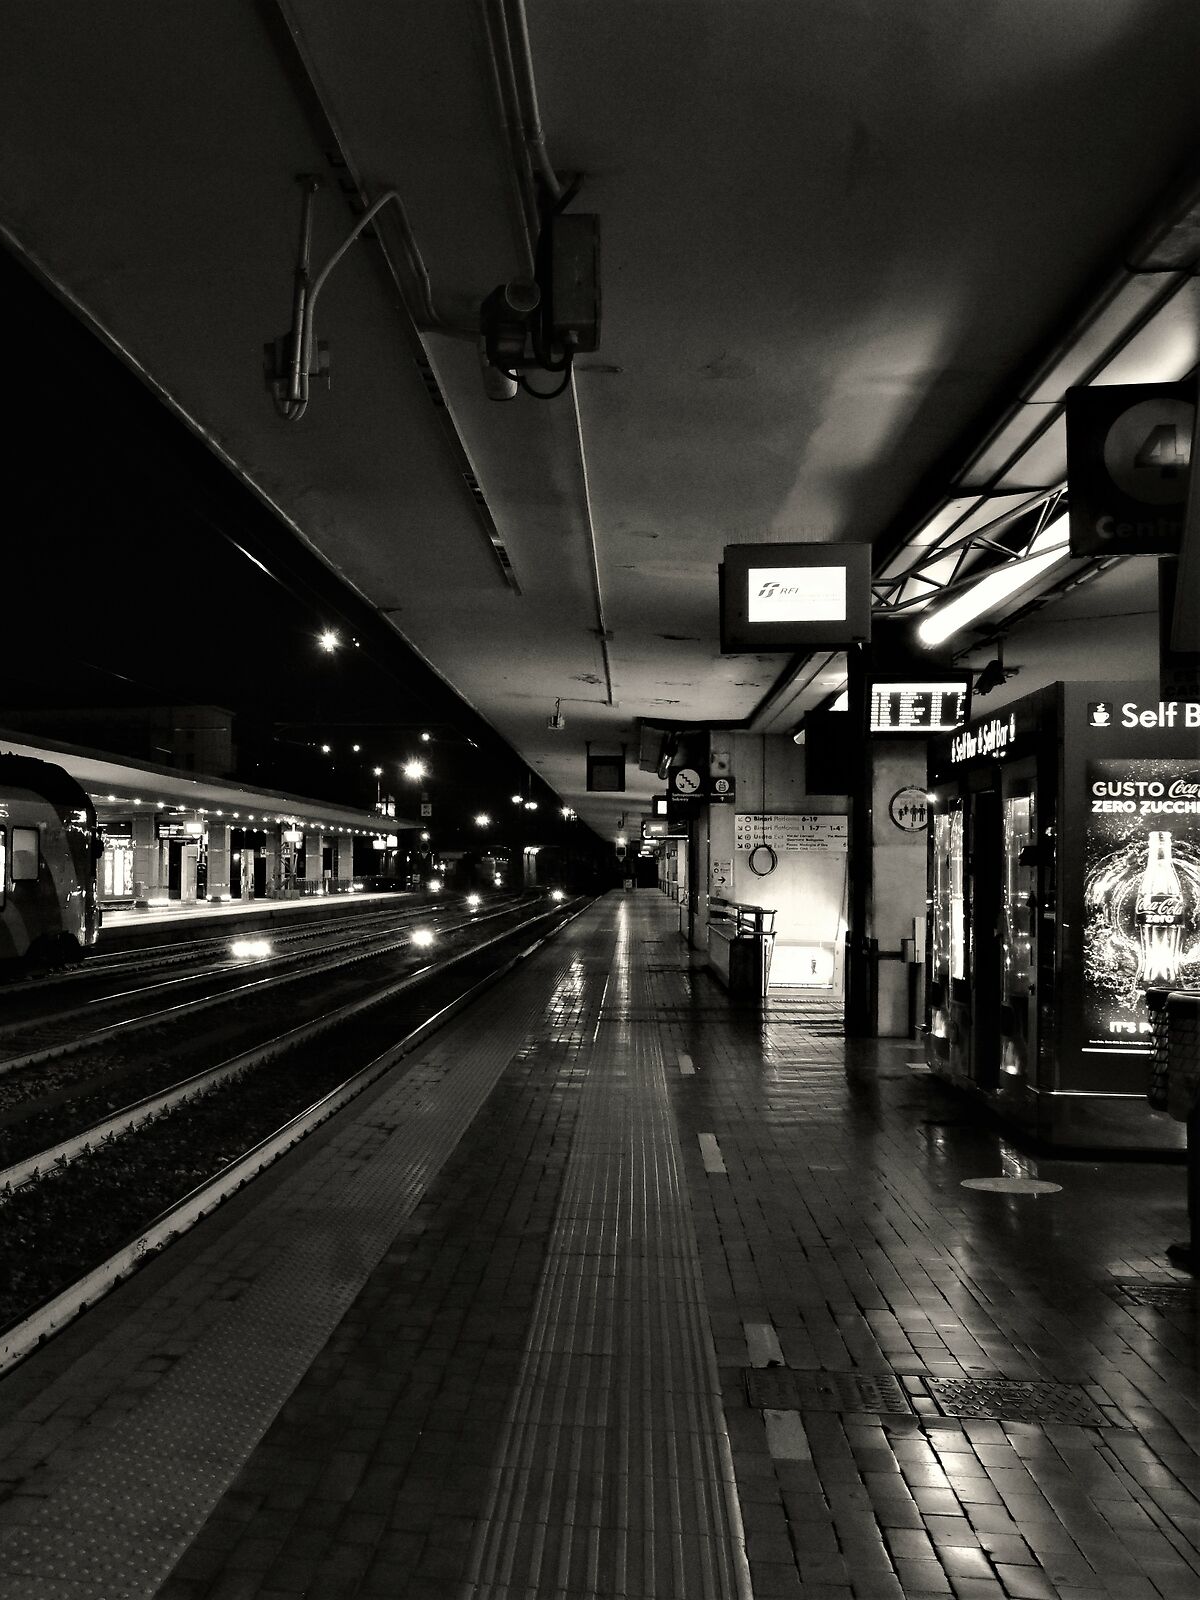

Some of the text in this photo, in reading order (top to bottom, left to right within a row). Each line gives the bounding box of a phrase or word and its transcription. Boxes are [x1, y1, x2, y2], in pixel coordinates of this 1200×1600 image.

[1134, 423, 1185, 479] 4
[1121, 702, 1178, 728] Self
[982, 719, 996, 756] Self
[996, 719, 1009, 748] Bar
[1092, 781, 1165, 797] GUSTO
[1091, 800, 1137, 813] ZERO
[1136, 897, 1184, 915] Coa-Cola
[1109, 1021, 1136, 1034] IT'S
